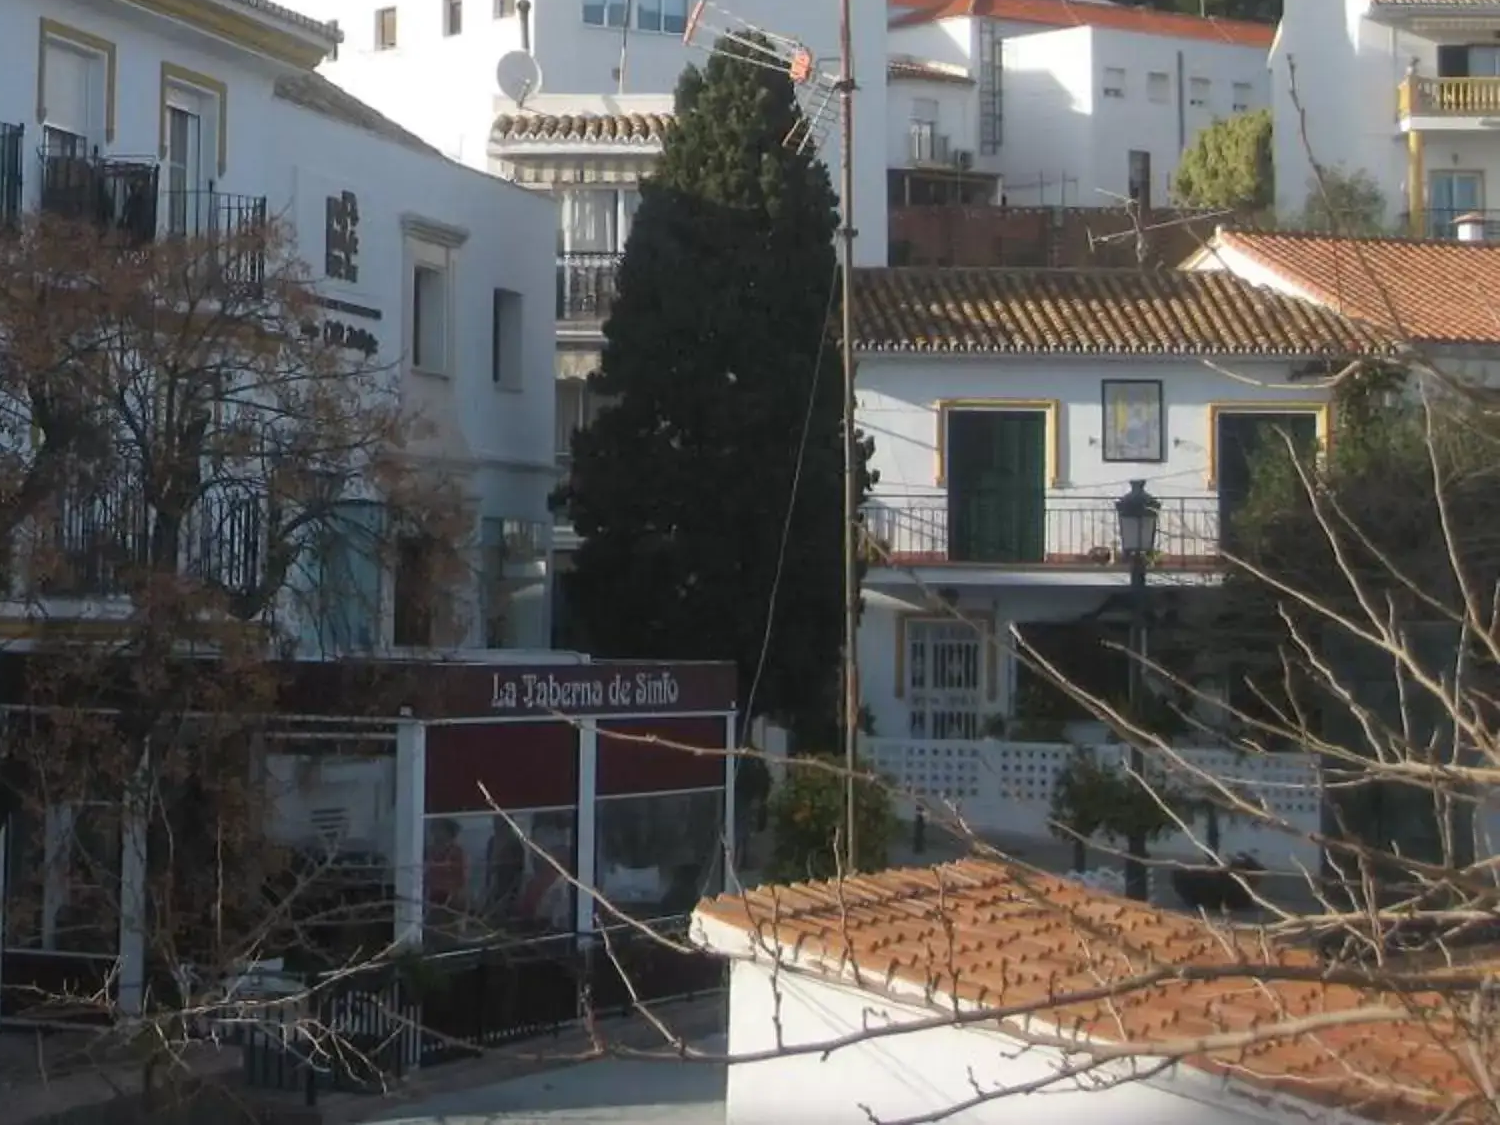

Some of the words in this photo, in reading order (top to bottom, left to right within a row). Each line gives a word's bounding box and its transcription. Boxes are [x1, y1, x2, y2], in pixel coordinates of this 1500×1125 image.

[491, 673, 517, 708] La
[521, 673, 604, 708] Taberna
[608, 673, 632, 706] de
